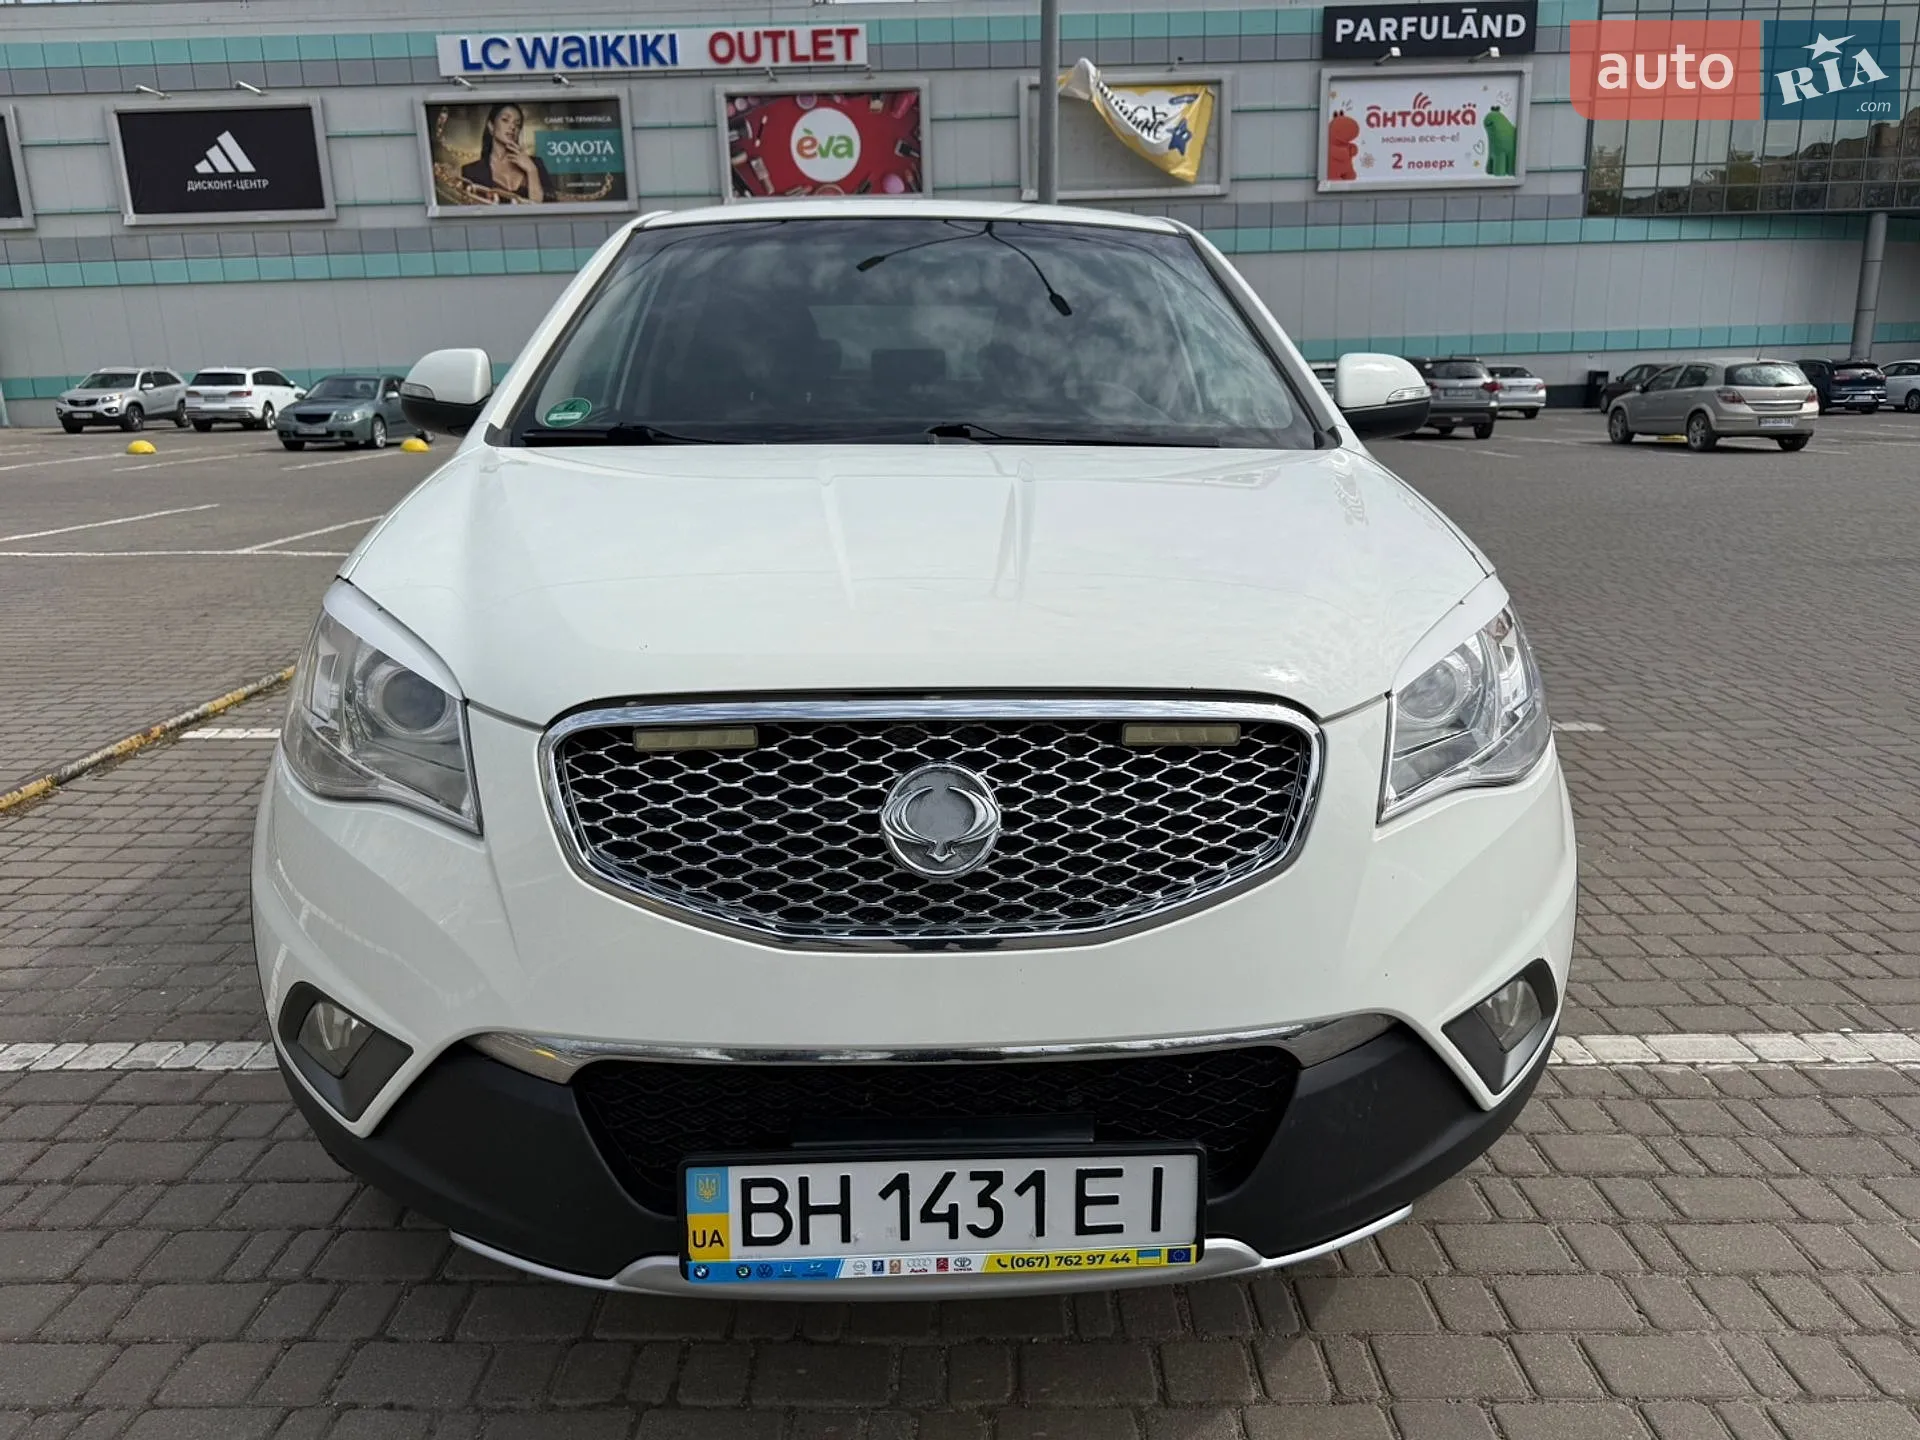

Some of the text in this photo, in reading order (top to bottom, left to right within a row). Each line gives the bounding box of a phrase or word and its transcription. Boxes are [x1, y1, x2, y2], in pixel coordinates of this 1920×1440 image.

[459, 36, 511, 71] LC
[708, 28, 860, 65] OUTLET
[546, 140, 616, 156] ЗОЛОТА
[1391, 153, 1455, 170] 2 поверх
[187, 179, 269, 192] ДИСКОНТ-ЦЕНТР
[740, 1167, 1163, 1247] BH 1431 EI
[692, 1229, 725, 1249] UA
[1010, 1252, 1131, 1270] (067) 762 97 44
